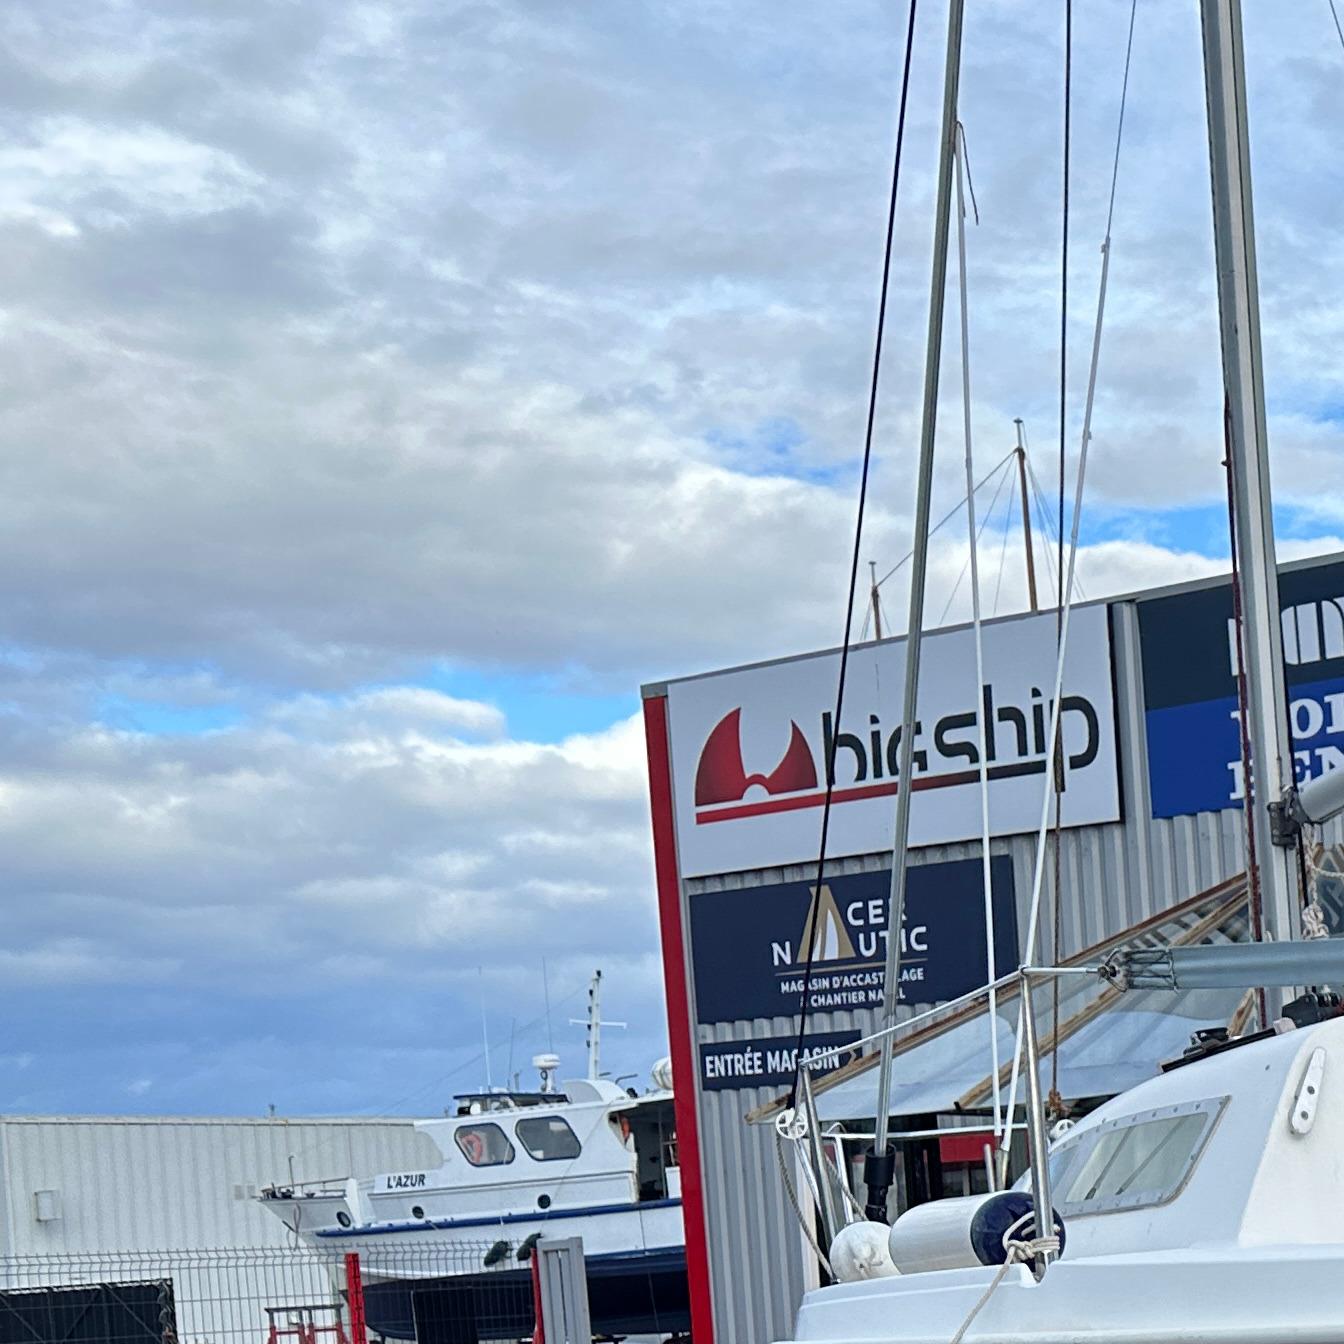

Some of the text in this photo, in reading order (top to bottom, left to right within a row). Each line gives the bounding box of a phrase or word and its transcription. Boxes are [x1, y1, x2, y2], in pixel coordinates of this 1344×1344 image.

[868, 987, 906, 1003] NAL
[705, 1046, 763, 1077] ENTRÉE
[387, 1174, 426, 1189] L'AZUR
